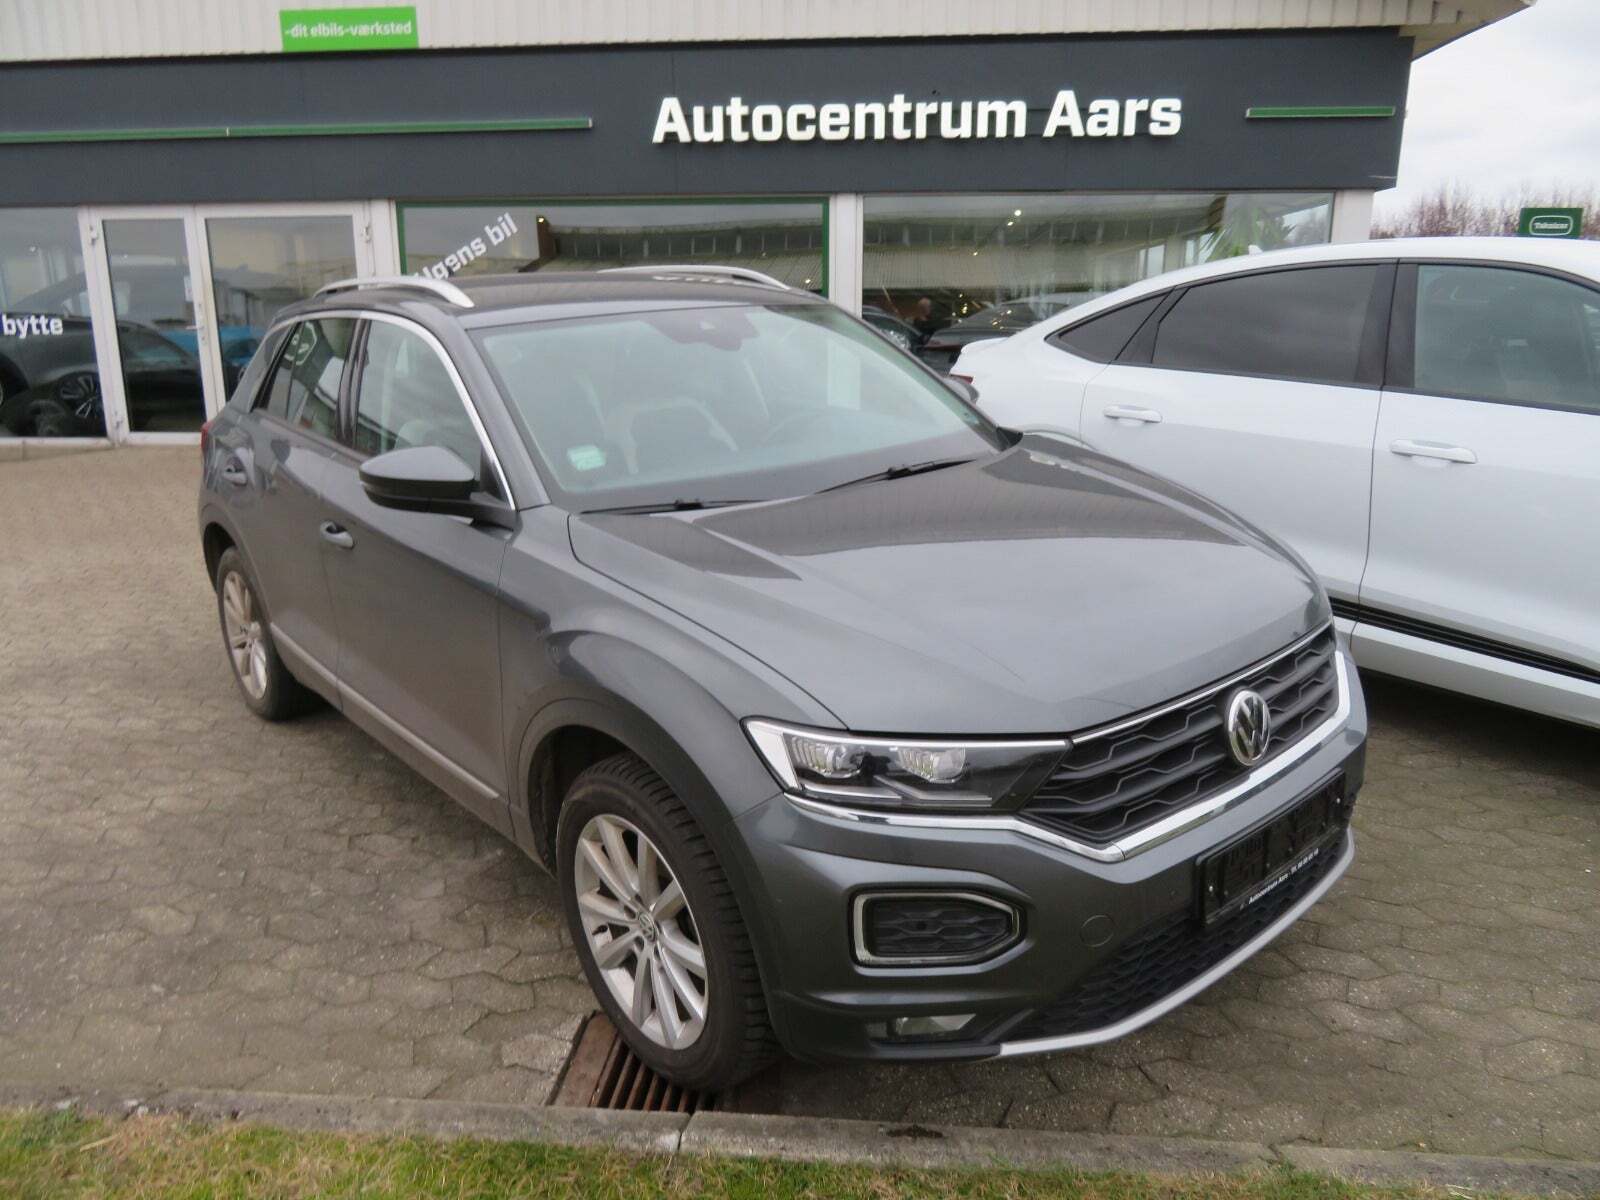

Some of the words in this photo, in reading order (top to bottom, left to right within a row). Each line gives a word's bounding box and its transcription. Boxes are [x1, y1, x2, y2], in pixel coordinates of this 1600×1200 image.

[310, 20, 412, 37] elbils-værksted
[652, 93, 1027, 144] Autocentrum
[1043, 89, 1183, 138] Aars
[484, 212, 518, 246] bil
[2, 314, 64, 339] bytte
